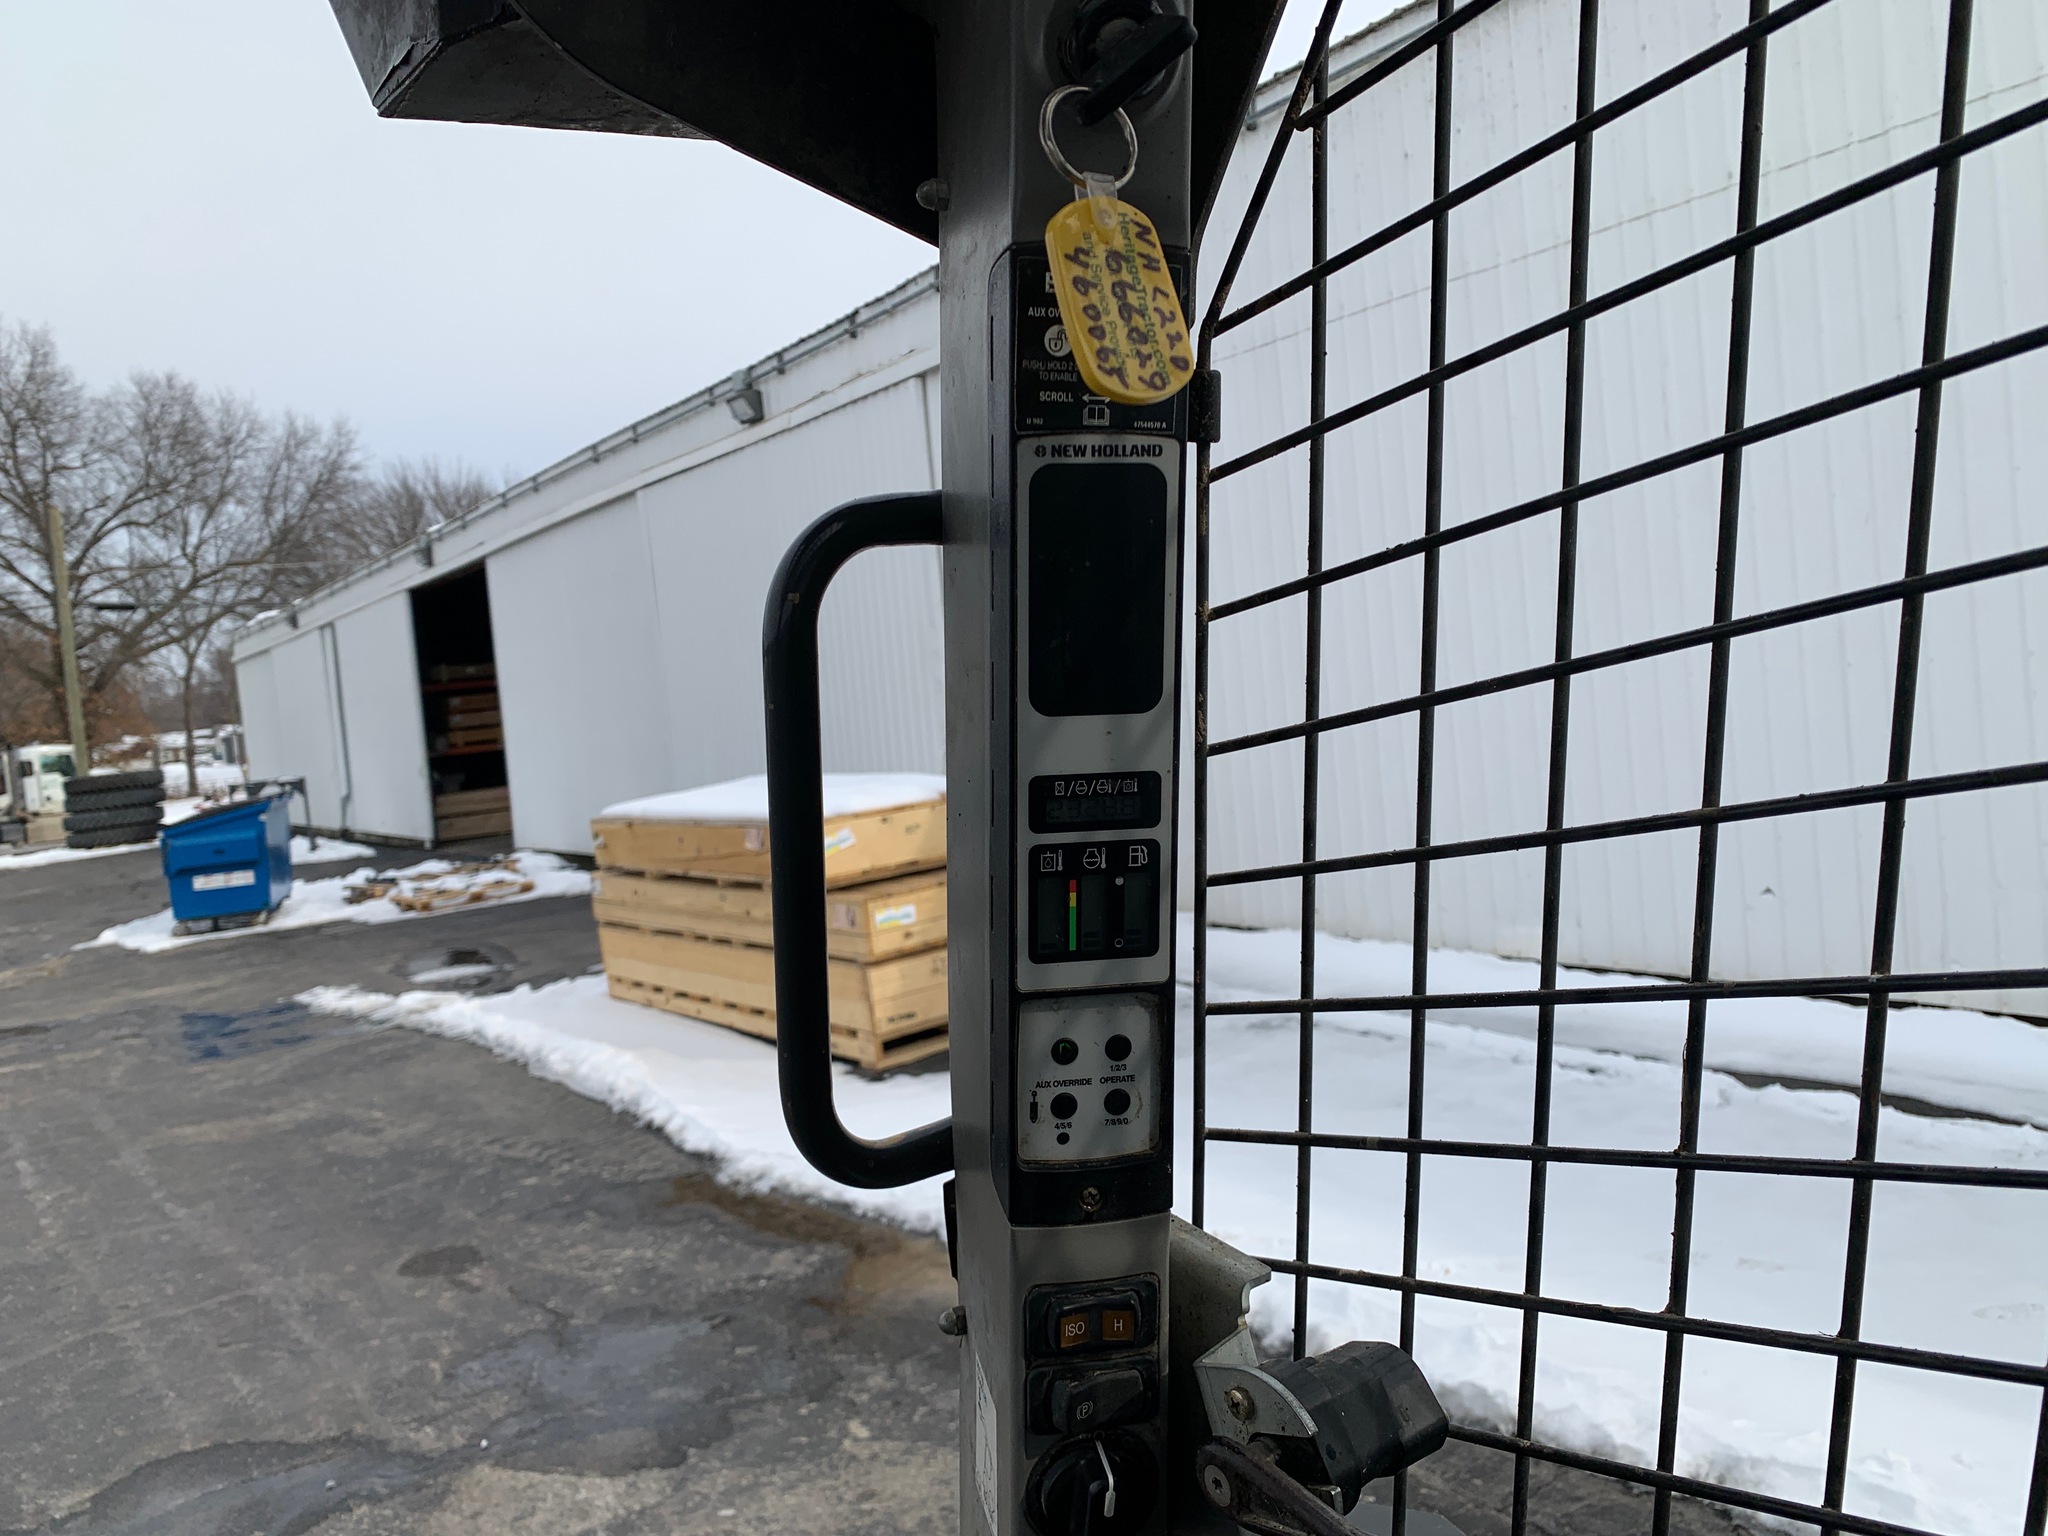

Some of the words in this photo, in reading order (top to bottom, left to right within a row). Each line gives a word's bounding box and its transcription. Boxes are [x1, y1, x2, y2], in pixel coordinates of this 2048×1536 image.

[1028, 306, 1046, 316] AUX
[1152, 287, 1190, 372] L220
[1047, 360, 1068, 370] HOLD
[1039, 371, 1049, 381] TO
[1050, 371, 1078, 382] ENABLE
[1039, 391, 1074, 403] SCROLL
[1051, 444, 1088, 457] NEW
[1091, 444, 1163, 457] HOLLAND
[1109, 1063, 1127, 1072] 1/2/3
[1035, 1080, 1052, 1089] AUX
[1052, 1077, 1093, 1088] OVERRIDE
[1099, 1074, 1136, 1085] OPERATE
[1053, 1121, 1072, 1130] 4/5/6
[1104, 1118, 1129, 1126] 7/8/9/0
[1065, 1321, 1085, 1337] ISO
[1113, 1318, 1123, 1332] H
